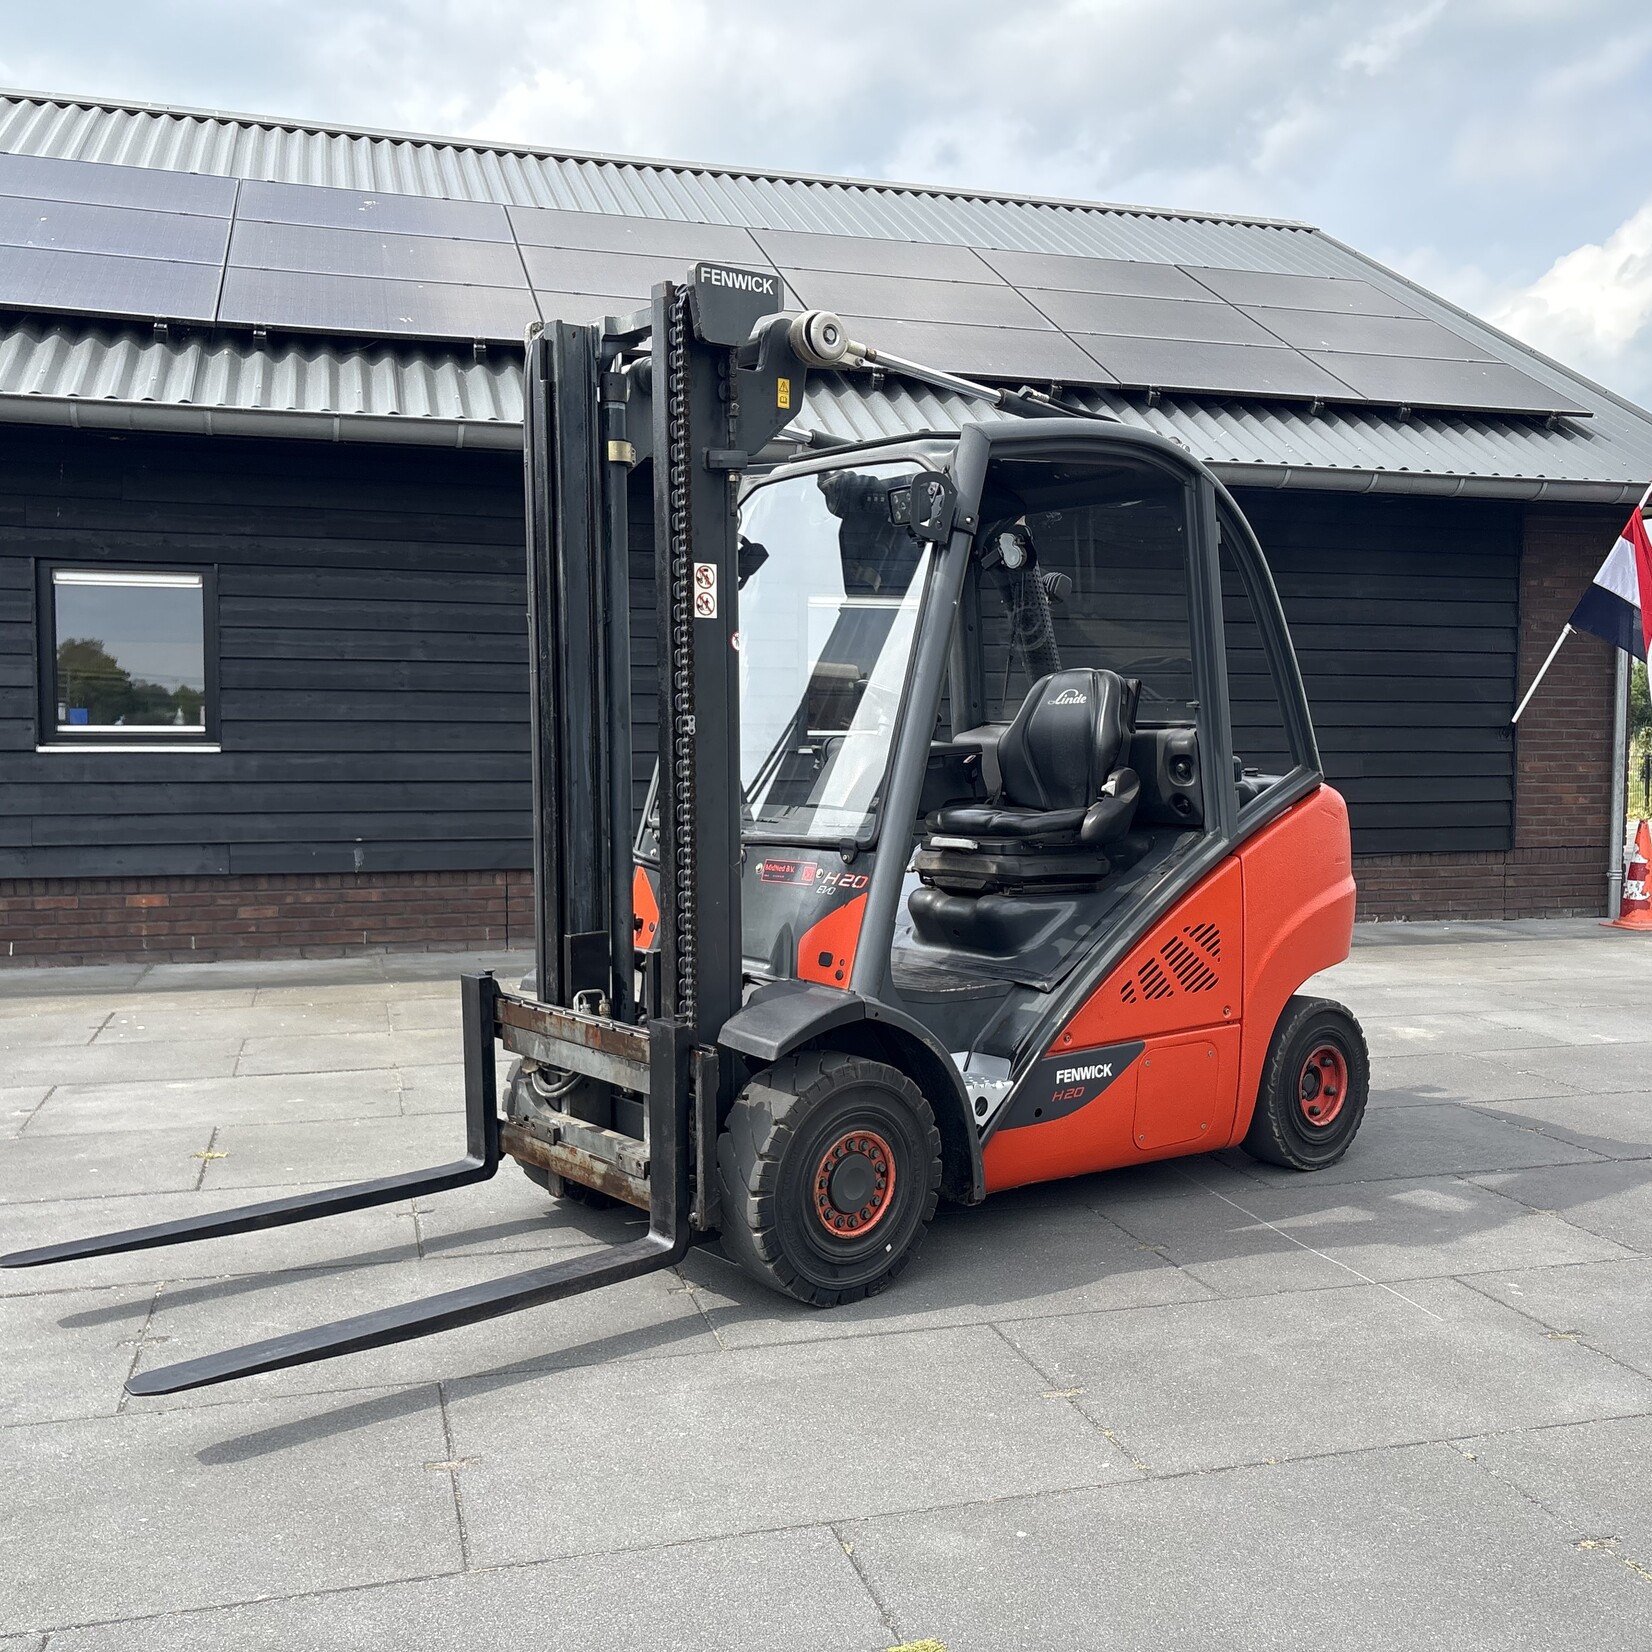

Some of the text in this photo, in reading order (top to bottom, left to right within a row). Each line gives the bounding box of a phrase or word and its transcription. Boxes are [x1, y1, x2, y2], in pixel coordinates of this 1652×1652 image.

[700, 267, 774, 295] FENWICK
[1047, 688, 1087, 705] Linde
[816, 885, 836, 895] EVO
[1056, 1063, 1112, 1084] FENWICK
[1052, 1086, 1085, 1102] H20
